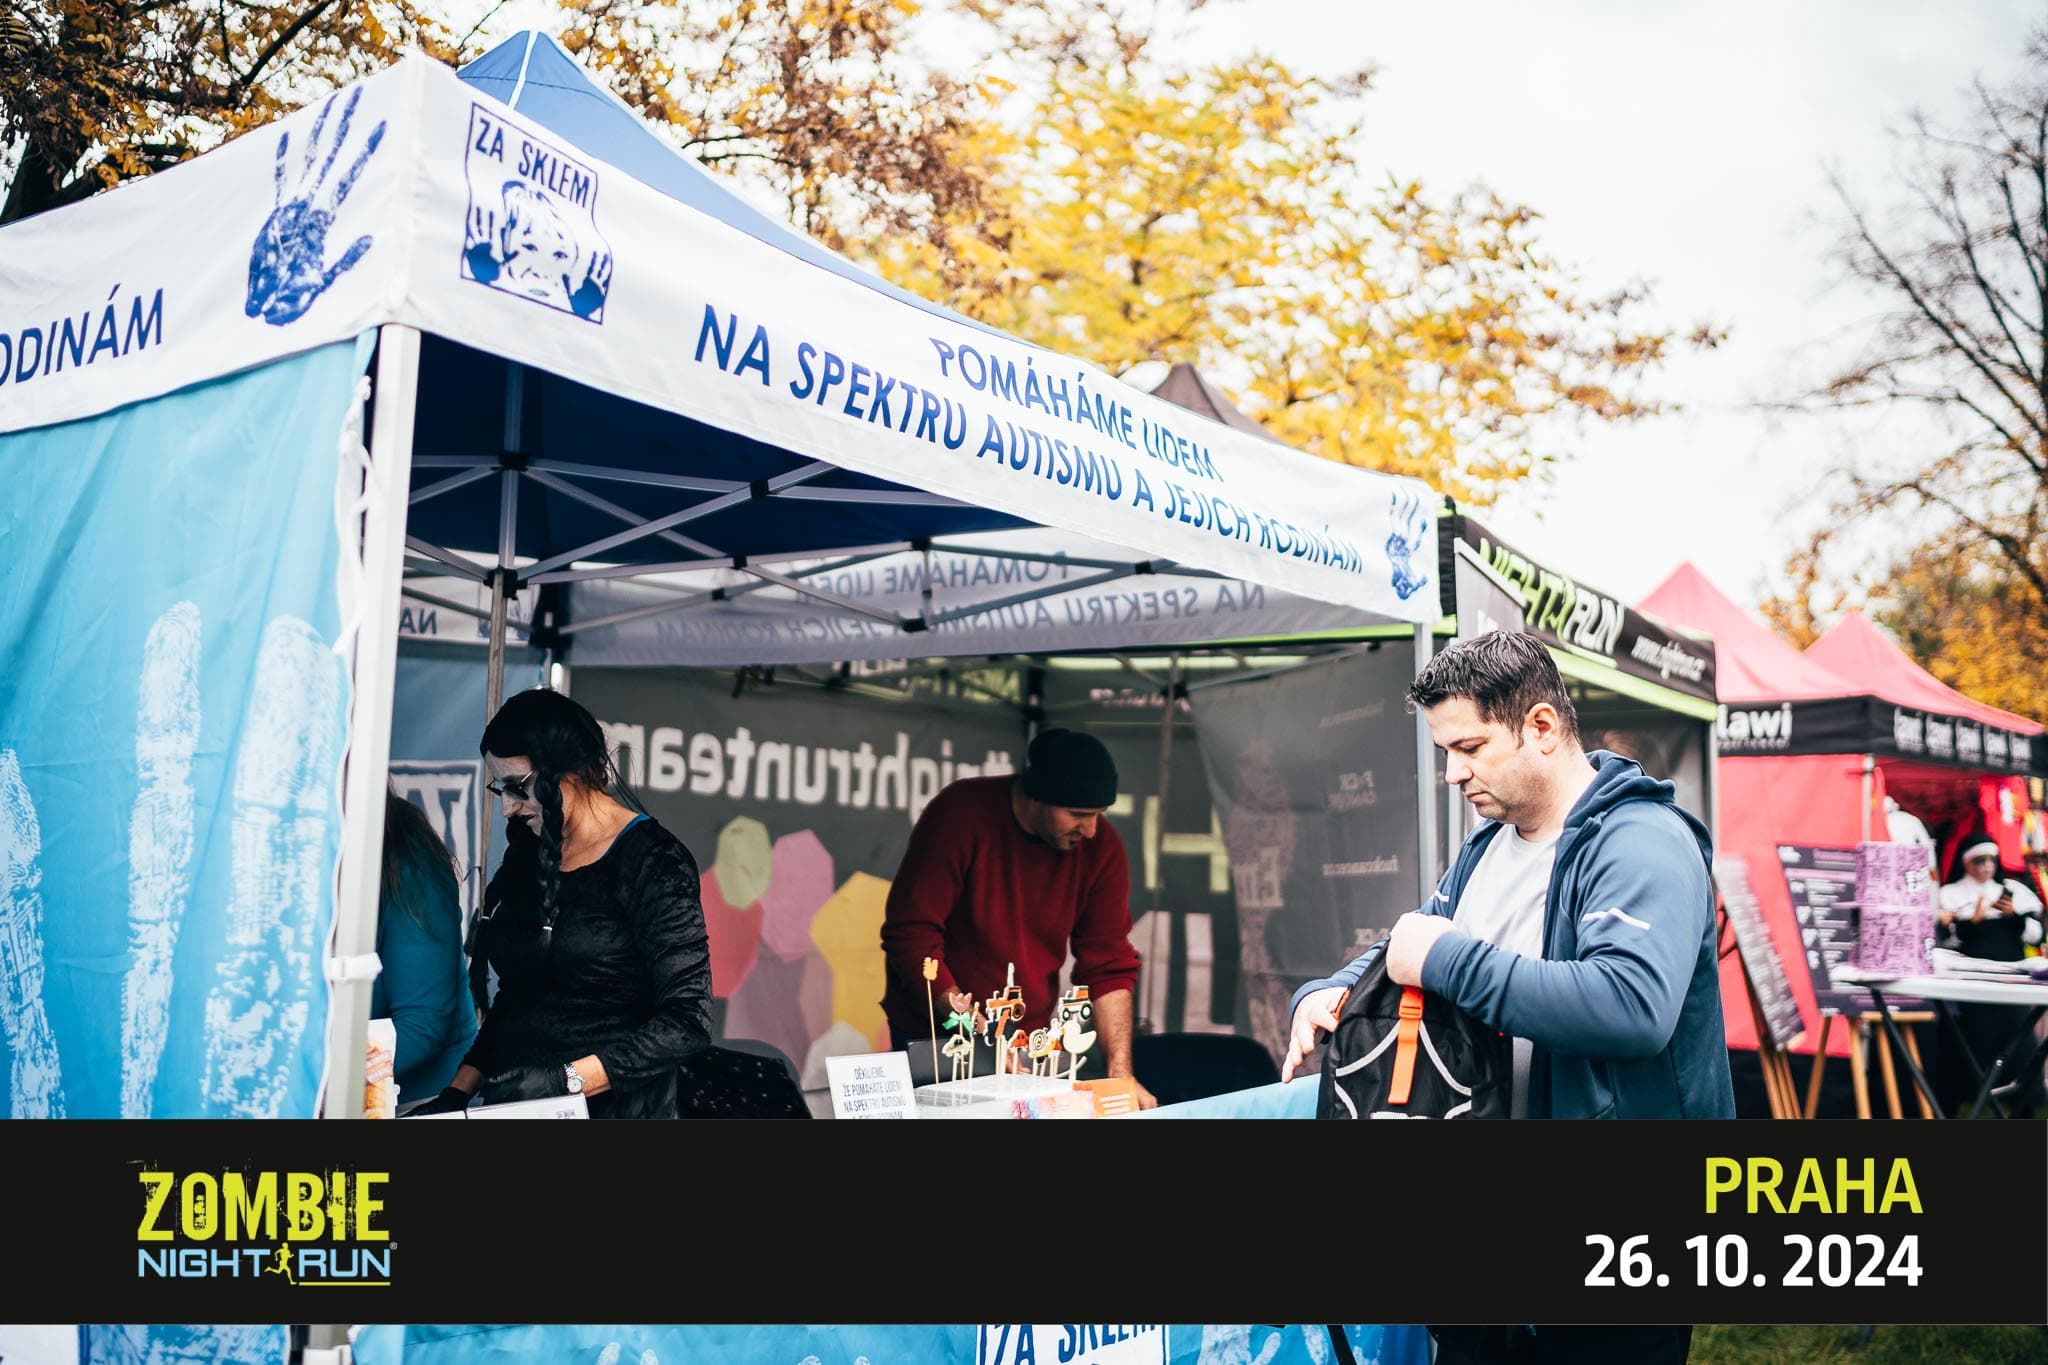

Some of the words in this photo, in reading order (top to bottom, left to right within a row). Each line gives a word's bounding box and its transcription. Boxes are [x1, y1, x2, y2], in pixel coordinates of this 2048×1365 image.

[475, 117, 503, 163] ZA
[518, 140, 590, 208] SKLEM
[695, 303, 770, 386] NA
[790, 342, 966, 450] SPEKTRU
[976, 414, 1122, 500] AUTISMU
[1132, 468, 1154, 512] A
[1164, 480, 1250, 542] JEJICH
[1254, 512, 1362, 574] RODINÁM
[929, 337, 1137, 450] POMÁHÁME
[1143, 417, 1224, 483] LIDEM
